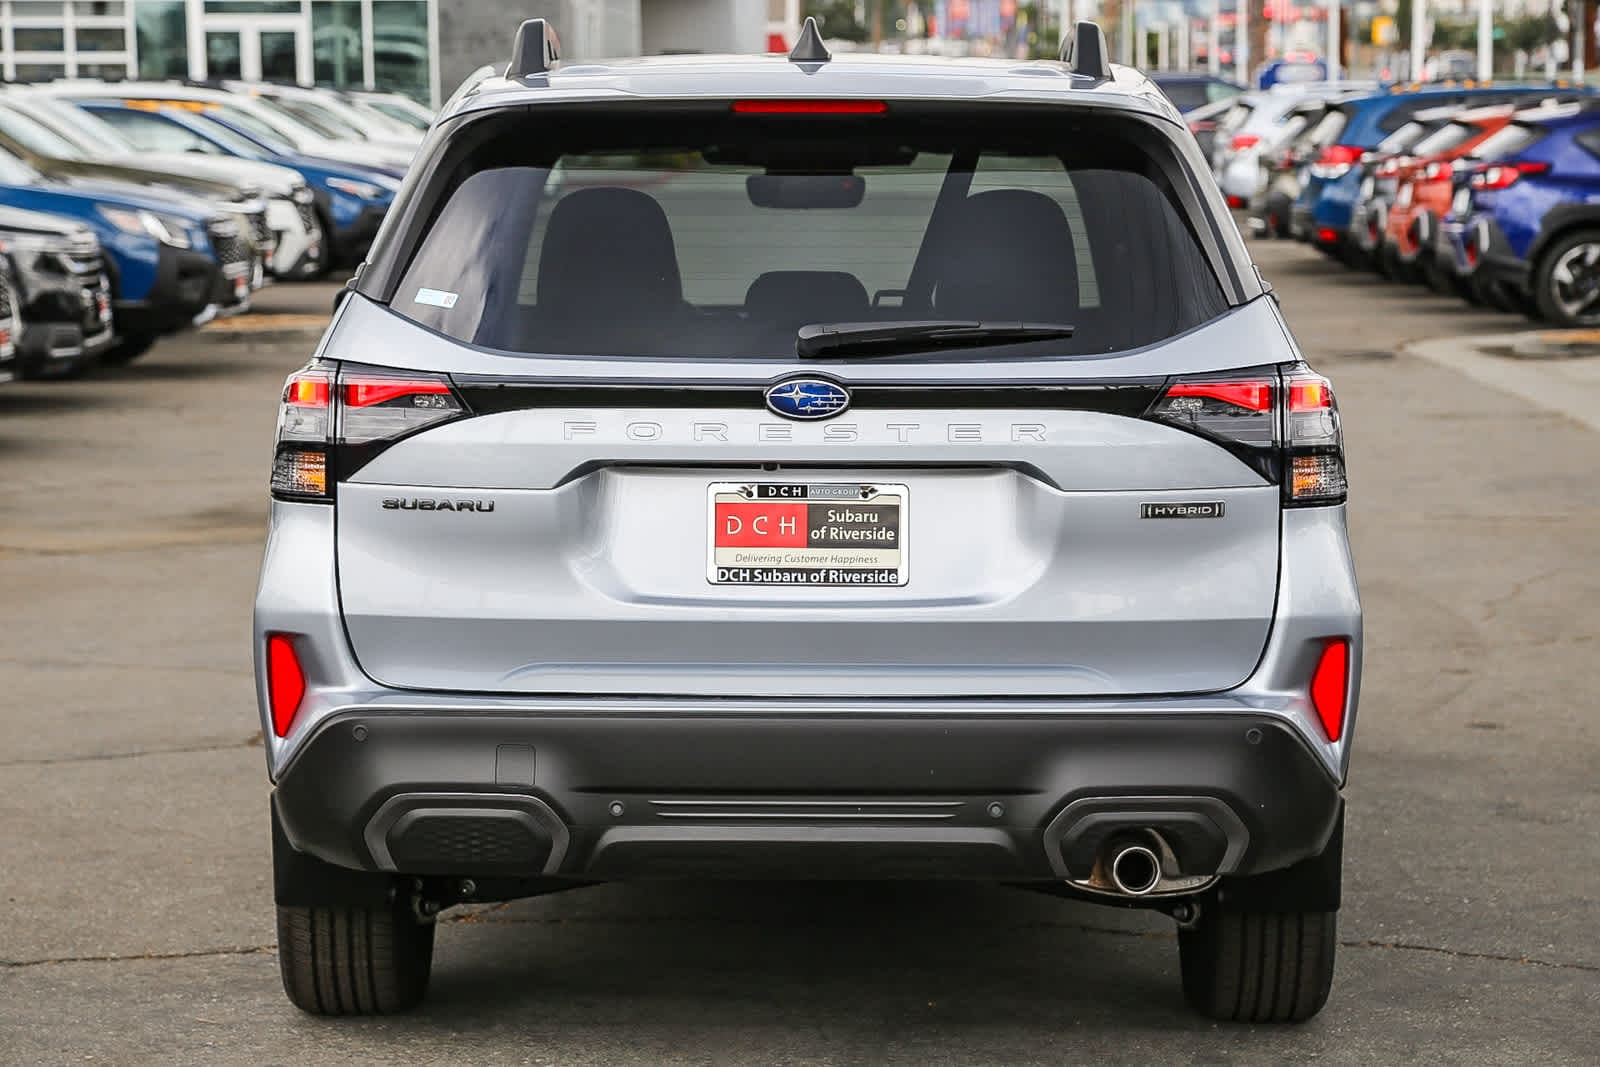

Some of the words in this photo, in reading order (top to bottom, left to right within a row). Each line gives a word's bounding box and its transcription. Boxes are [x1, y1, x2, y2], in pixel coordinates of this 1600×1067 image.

[563, 421, 1048, 442] FORESTER
[810, 488, 831, 496] AUTO
[832, 488, 859, 496] GROUP
[382, 498, 495, 512] SUBARU
[1155, 506, 1212, 515] HYBRID
[827, 509, 879, 523] Subaru
[726, 515, 797, 535] DCH
[811, 527, 826, 540] of
[830, 527, 895, 541] Riverside
[735, 553, 782, 566] Delivering
[784, 554, 828, 564] Customer
[830, 554, 878, 566] Happiness
[717, 569, 750, 582] DCH
[754, 569, 807, 583] Subaru
[810, 569, 826, 583] of
[829, 569, 898, 584] Riverside
